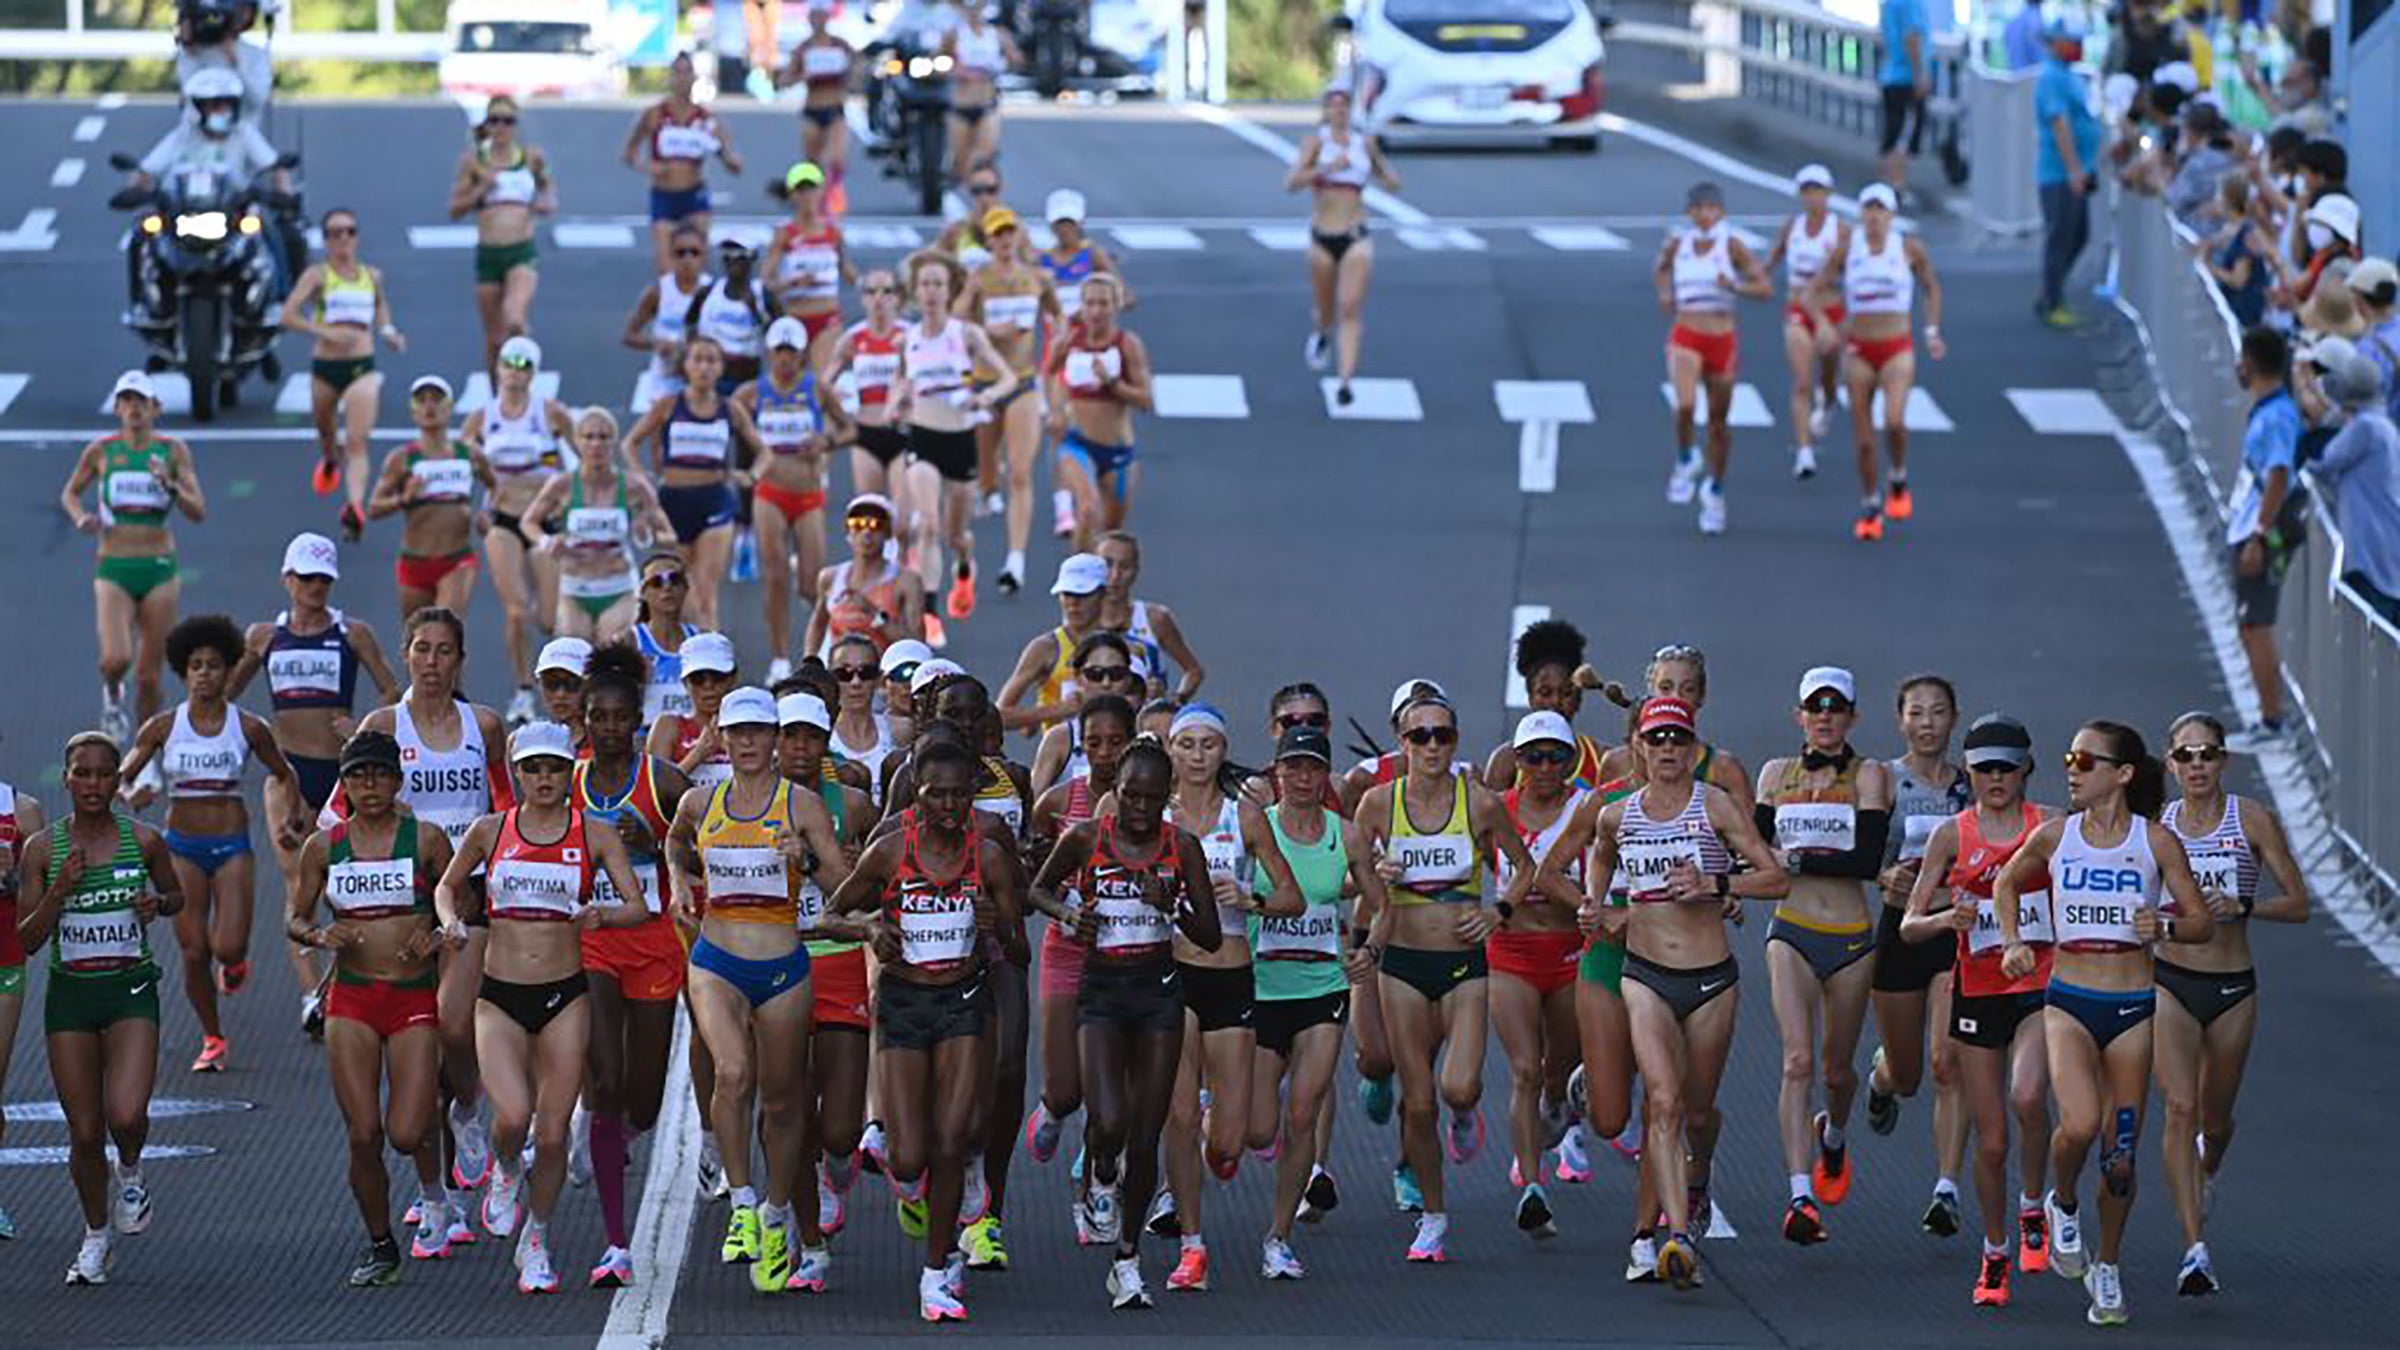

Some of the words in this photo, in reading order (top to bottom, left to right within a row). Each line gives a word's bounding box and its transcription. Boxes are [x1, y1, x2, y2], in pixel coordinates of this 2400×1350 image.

[411, 768, 481, 793] SUISSE
[1403, 848, 1457, 868] DIVER
[335, 873, 406, 894] TORRES
[503, 876, 567, 894] ICHIYAMA
[1096, 880, 1144, 897] KEN
[2063, 867, 2142, 893] USA
[901, 893, 974, 914] KENYA
[1979, 906, 2039, 931] MDA
[2066, 905, 2132, 924] SEIDEL
[61, 923, 139, 944] KHATALA
[1262, 916, 1334, 937] MASLOVA
